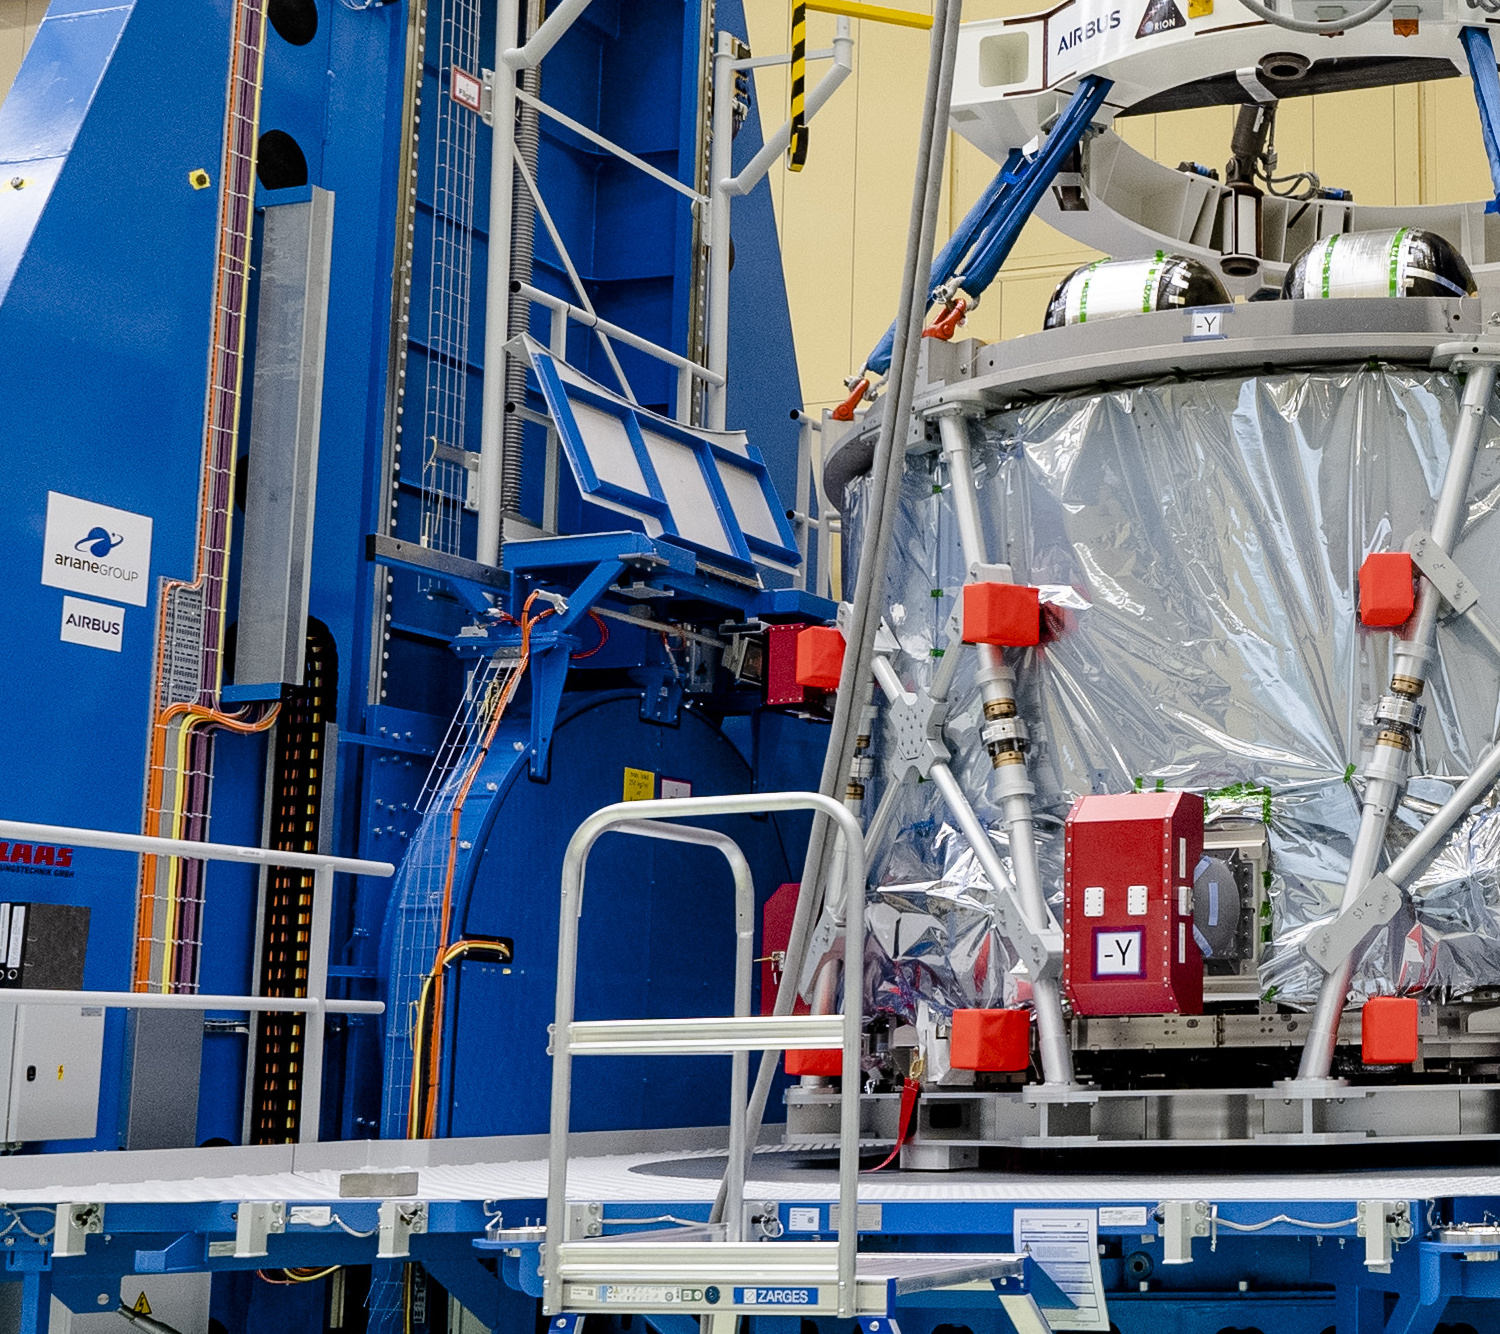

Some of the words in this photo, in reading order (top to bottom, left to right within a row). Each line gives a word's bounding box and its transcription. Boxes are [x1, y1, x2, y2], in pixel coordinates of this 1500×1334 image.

[1057, 9, 1121, 56] AIRBUS
[1195, 316, 1217, 333] -Y
[65, 613, 121, 636] AIRBUS
[1104, 939, 1132, 966] -Y
[757, 1289, 809, 1303] ZARGES
